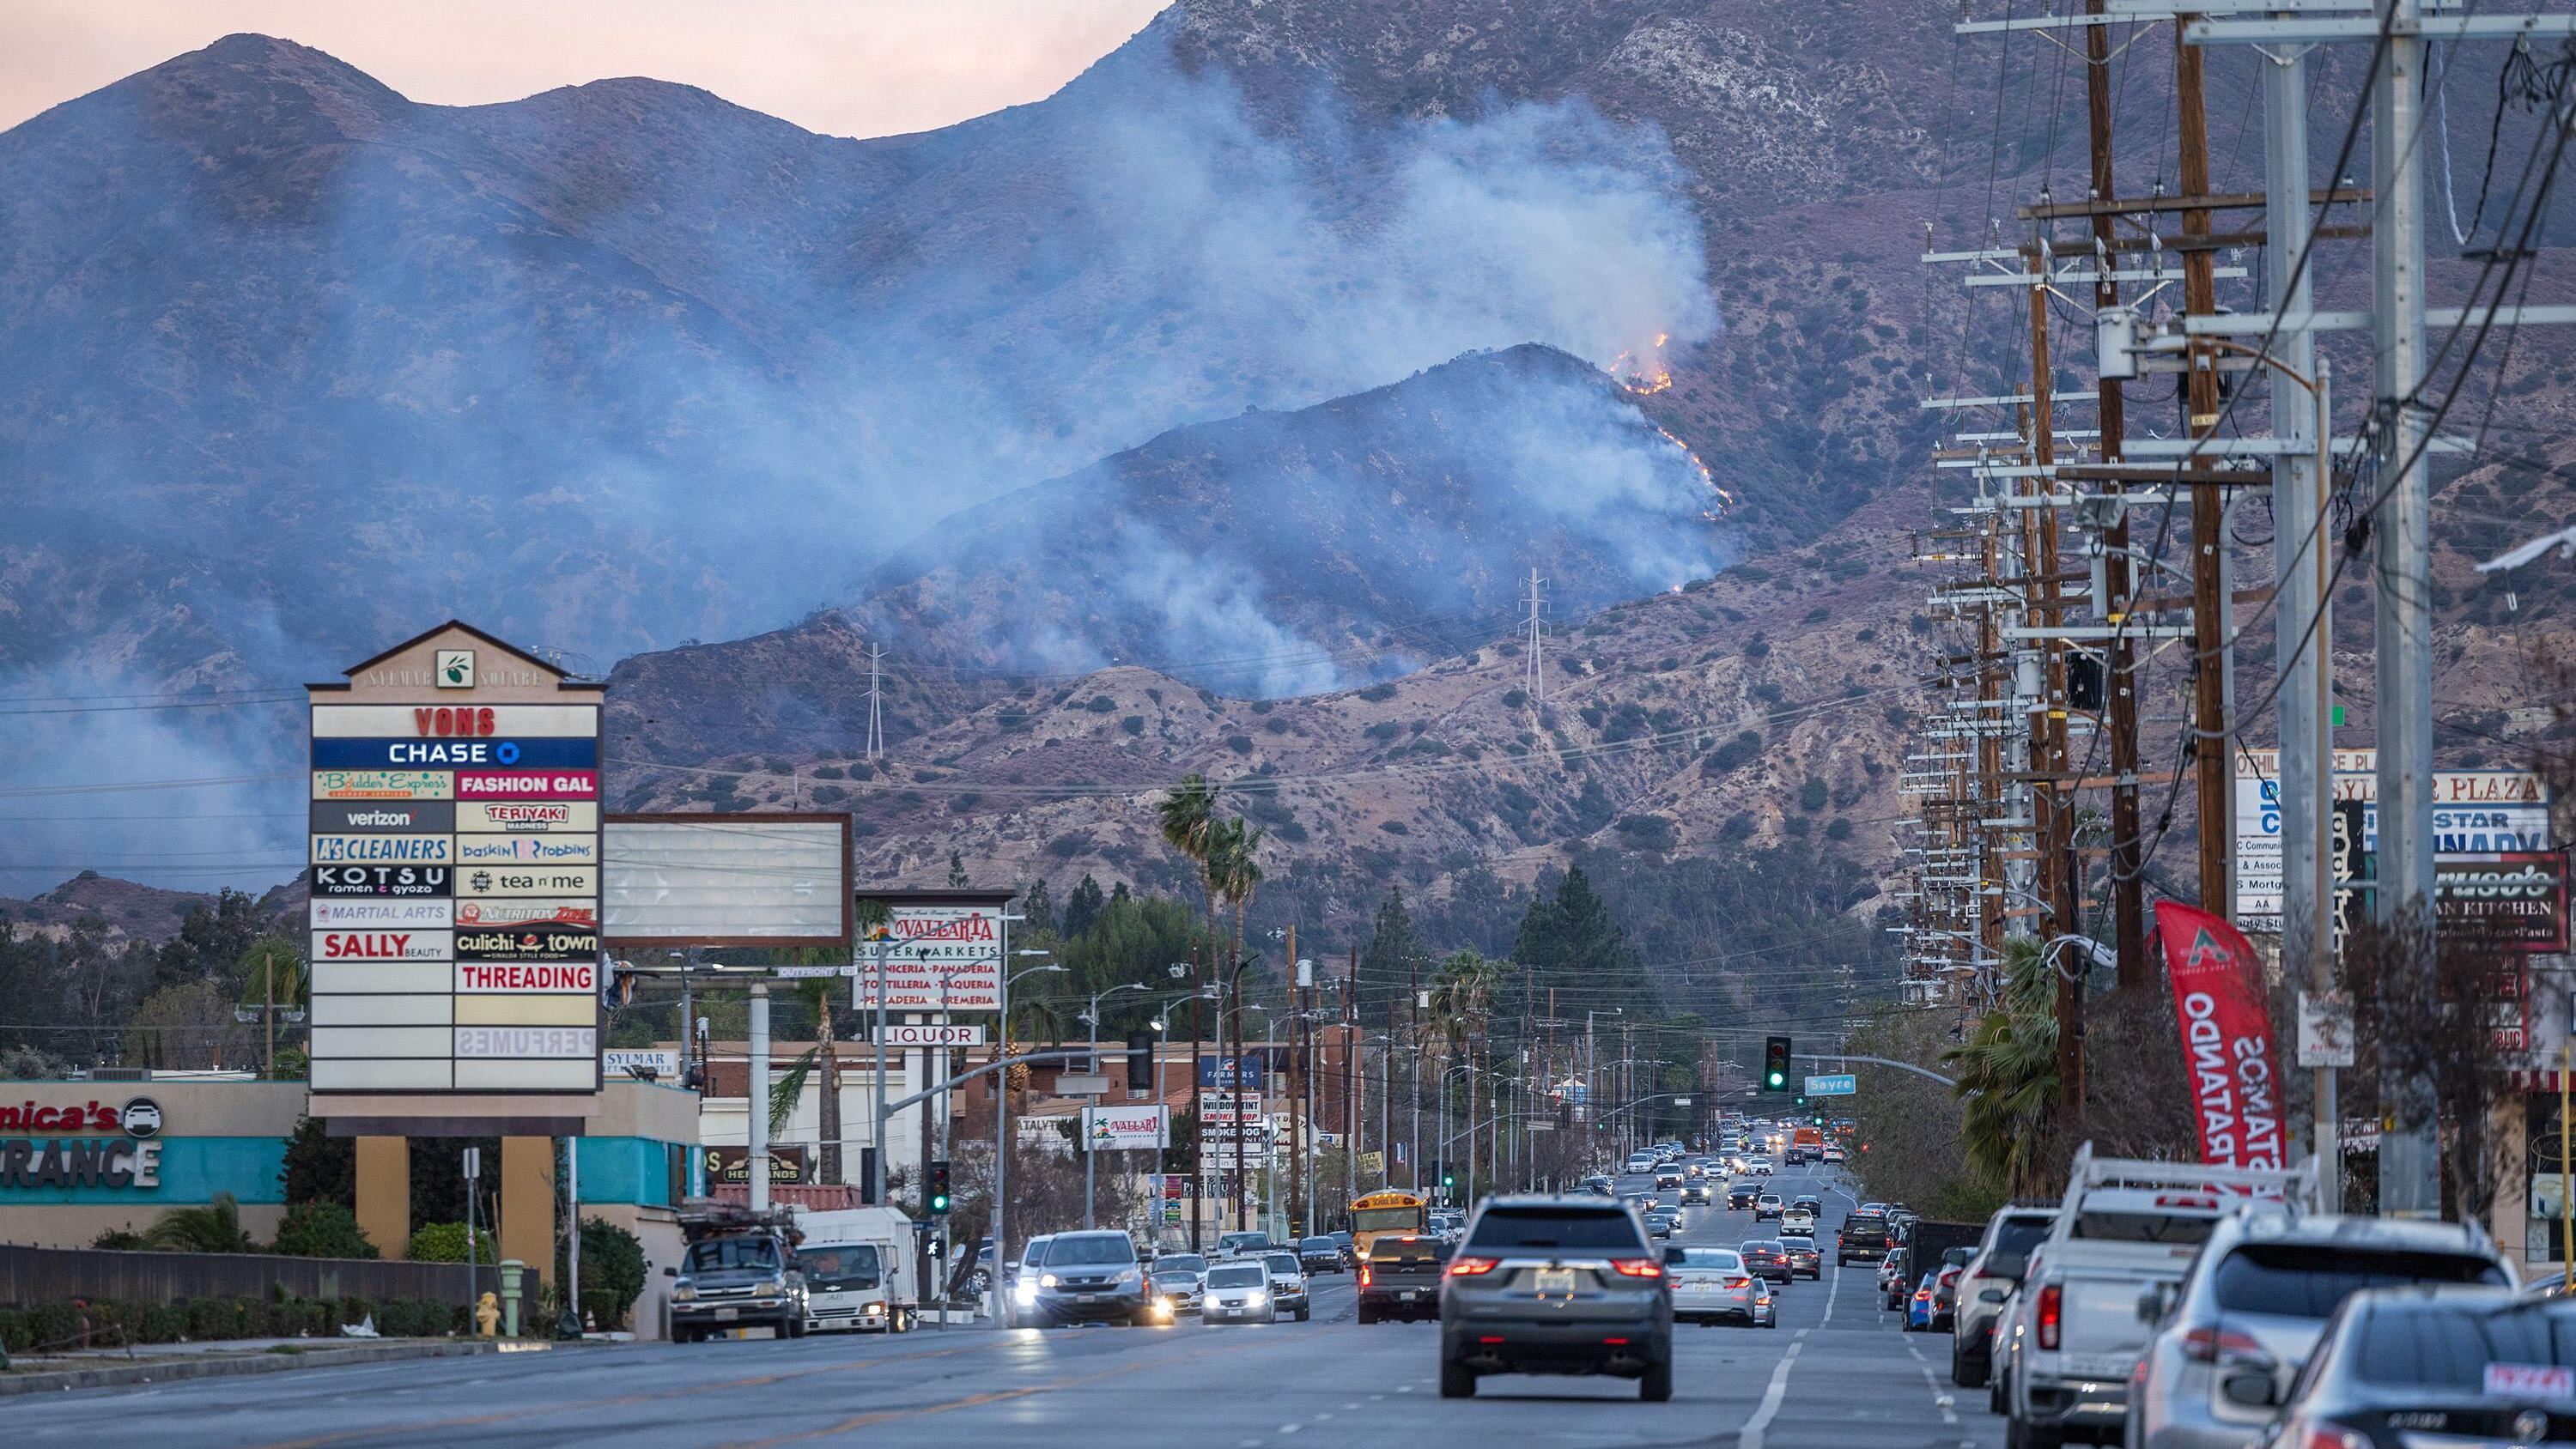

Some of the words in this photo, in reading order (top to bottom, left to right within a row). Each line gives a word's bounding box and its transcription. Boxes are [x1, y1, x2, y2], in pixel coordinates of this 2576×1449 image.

[369, 671, 430, 686] SYLMAR
[480, 671, 540, 686] SQUARE
[415, 707, 495, 737] VONS
[389, 744, 488, 763] CHASE
[2236, 755, 2280, 773] OTHIL
[389, 773, 447, 796] Express
[461, 777, 549, 792] FASHION
[553, 777, 593, 792] GAL
[2450, 778, 2541, 801] PLAZA
[348, 810, 410, 826] verizon
[489, 807, 567, 820] TERIYAKI
[2433, 813, 2509, 828] STAR
[346, 840, 447, 859] CLEANERS
[463, 844, 511, 858] baskin
[543, 844, 591, 857] robbins
[2246, 841, 2282, 850] Communi
[317, 867, 445, 885] KOTSU
[501, 876, 533, 888] tea
[552, 876, 584, 888] me
[392, 885, 433, 895] gyoza
[2250, 880, 2282, 890] Mortg
[332, 906, 399, 919] MARTIAL
[404, 906, 445, 919] ARTS
[2464, 901, 2552, 916] KITCHEN
[2238, 919, 2260, 929] auty
[2266, 919, 2283, 928] Stu
[325, 934, 411, 958] SALLY
[405, 949, 442, 957] BEAUTY
[457, 933, 515, 951] culichi
[858, 946, 997, 957] SUERMARKETS
[863, 965, 927, 974] CANICERIA
[463, 967, 592, 988] THREADING
[865, 980, 932, 989] TOTILLERIA
[938, 980, 995, 989] TAQUERIA
[865, 996, 928, 1004] PESADERIA
[608, 1053, 665, 1064] SYLMAR
[1811, 1080, 1850, 1091] Sayre
[1203, 1101, 1236, 1110] WIDOW
[0, 1100, 118, 1131] nica's
[1110, 1117, 1164, 1133] VALLART
[1202, 1128, 1236, 1137] SMKE
[1242, 1128, 1260, 1137] OG
[2, 1139, 163, 1188] RANCE
